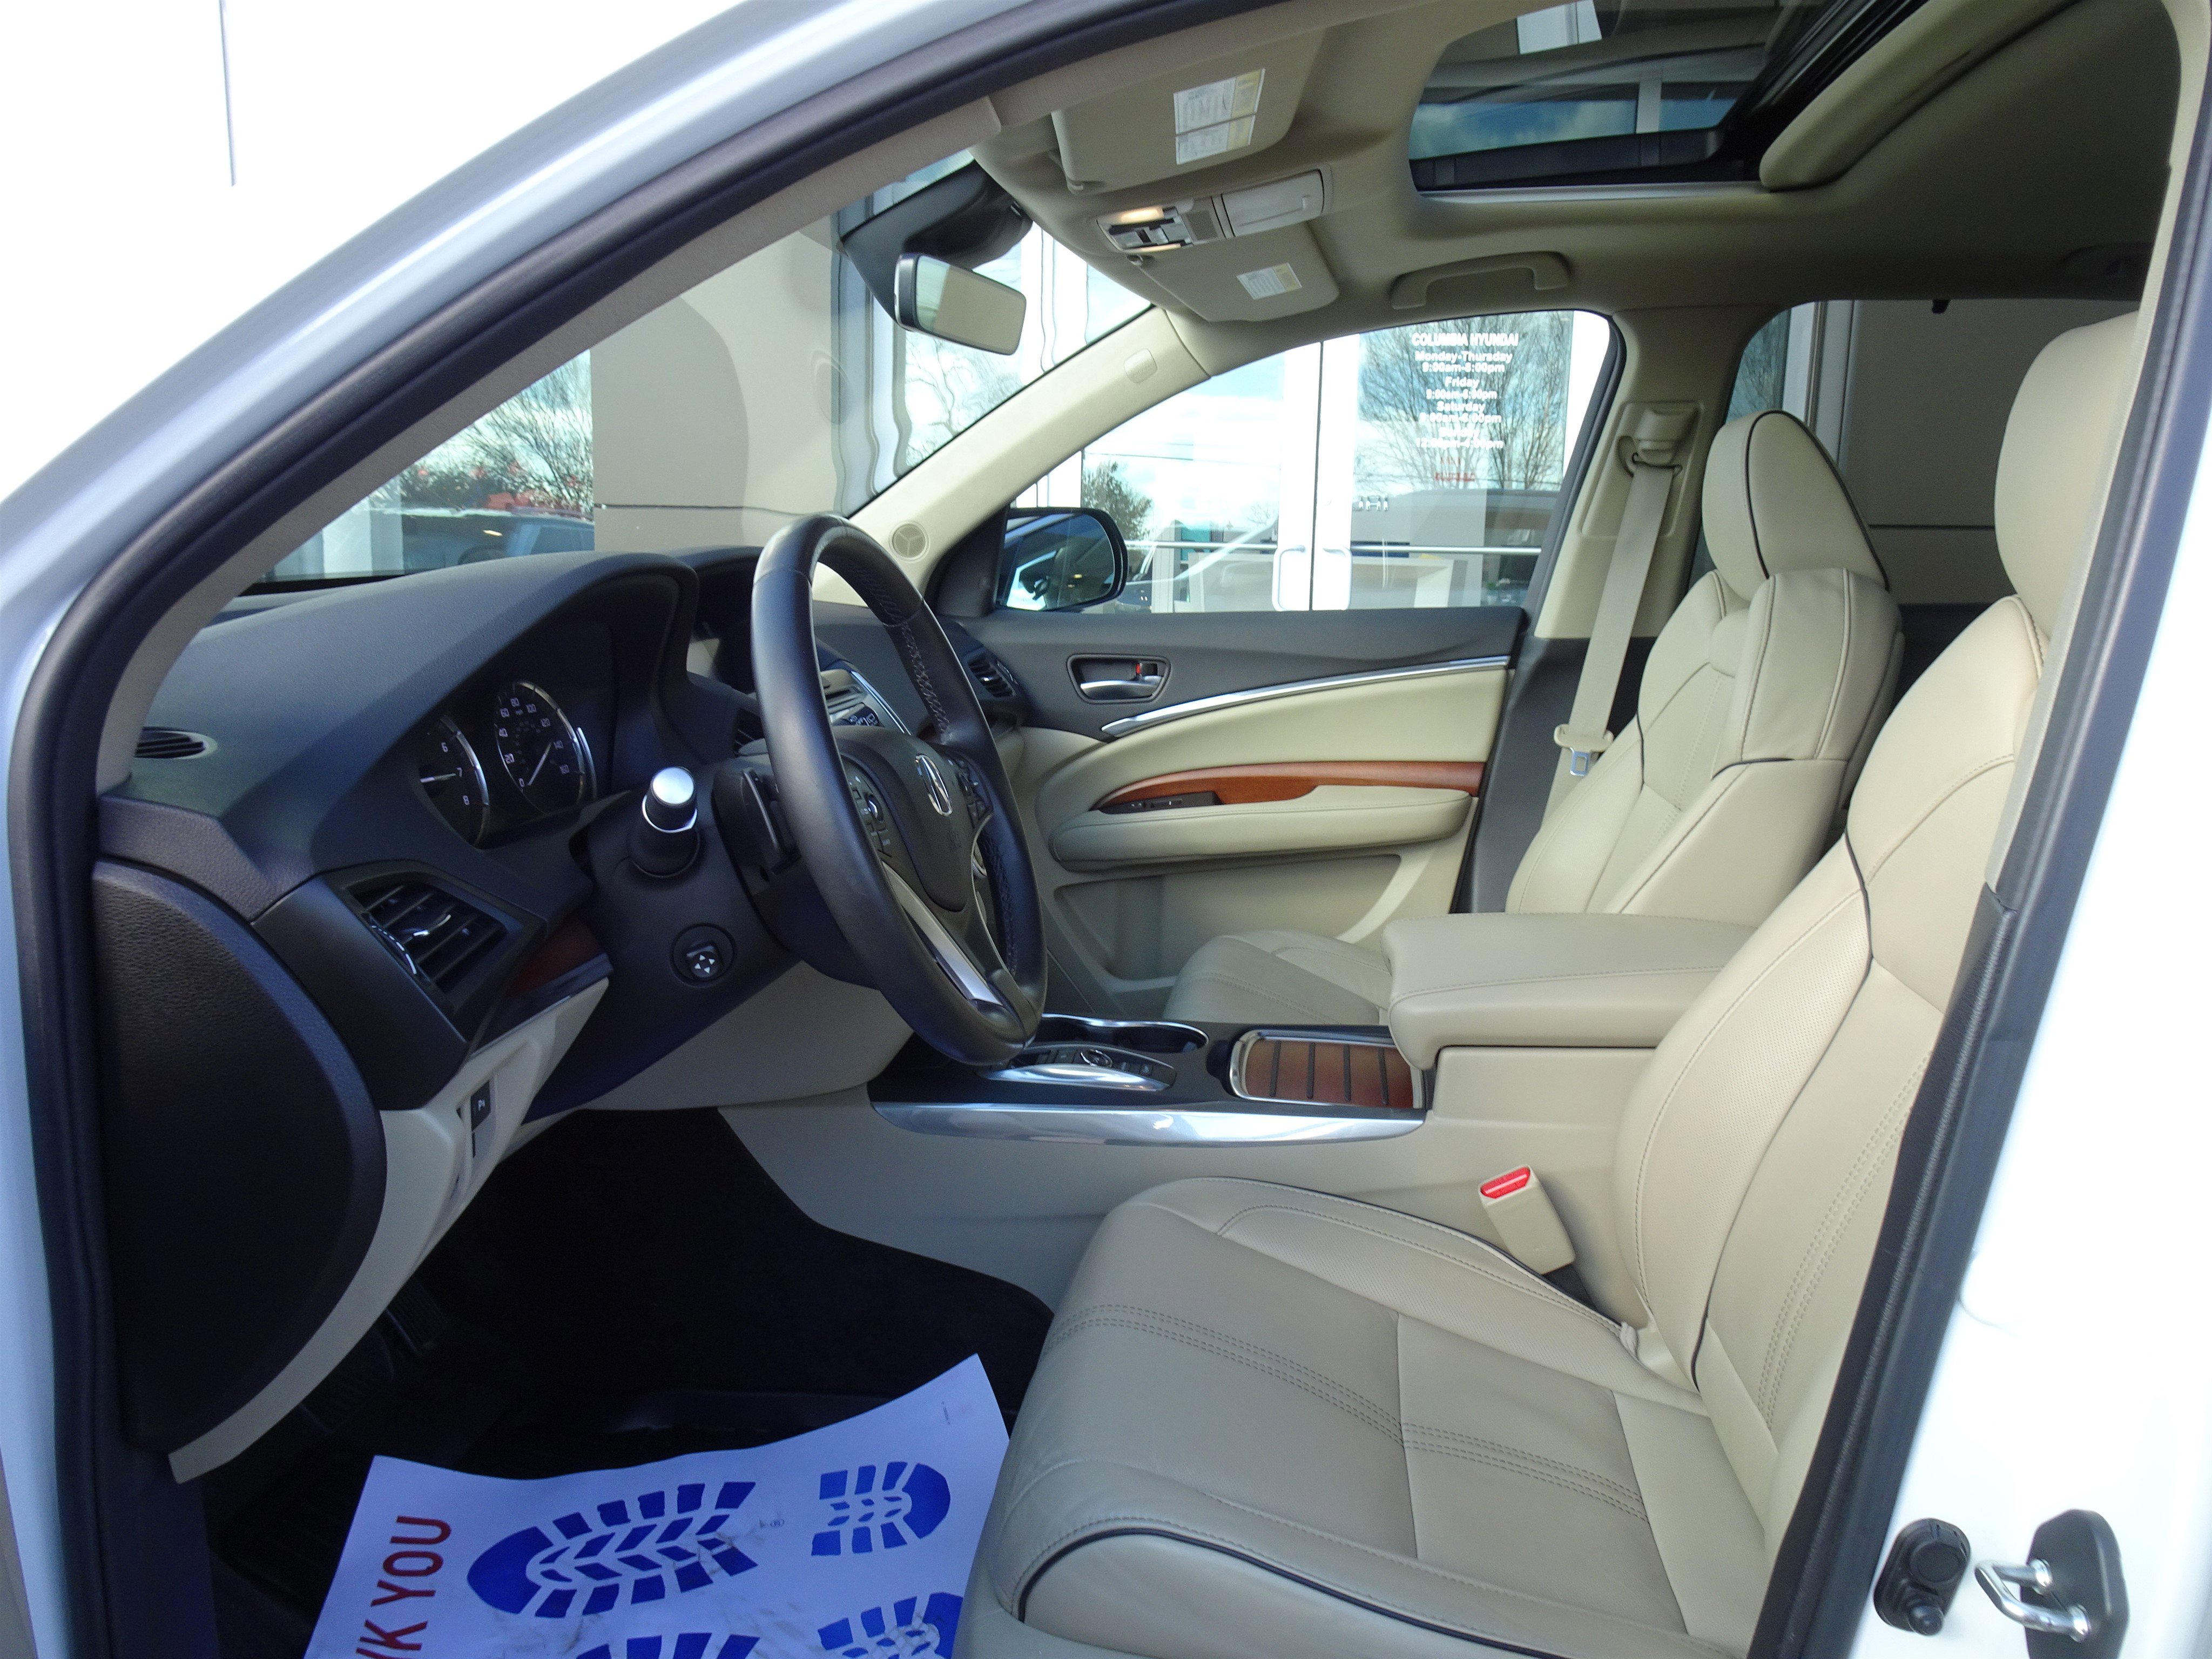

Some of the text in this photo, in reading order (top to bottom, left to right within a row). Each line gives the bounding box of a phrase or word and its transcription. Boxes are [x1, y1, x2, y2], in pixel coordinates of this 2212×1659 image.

[1412, 333, 1519, 346] COLUMBIA HYUNDAI
[1415, 350, 1513, 363] Monday-Thursday
[1445, 376, 1480, 389] Friday
[1437, 401, 1485, 413] Saturday
[441, 742, 448, 752] 6
[457, 767, 462, 777] 7
[518, 778, 525, 787] 0
[463, 795, 470, 805] 8
[370, 1515, 451, 1607] YOU
